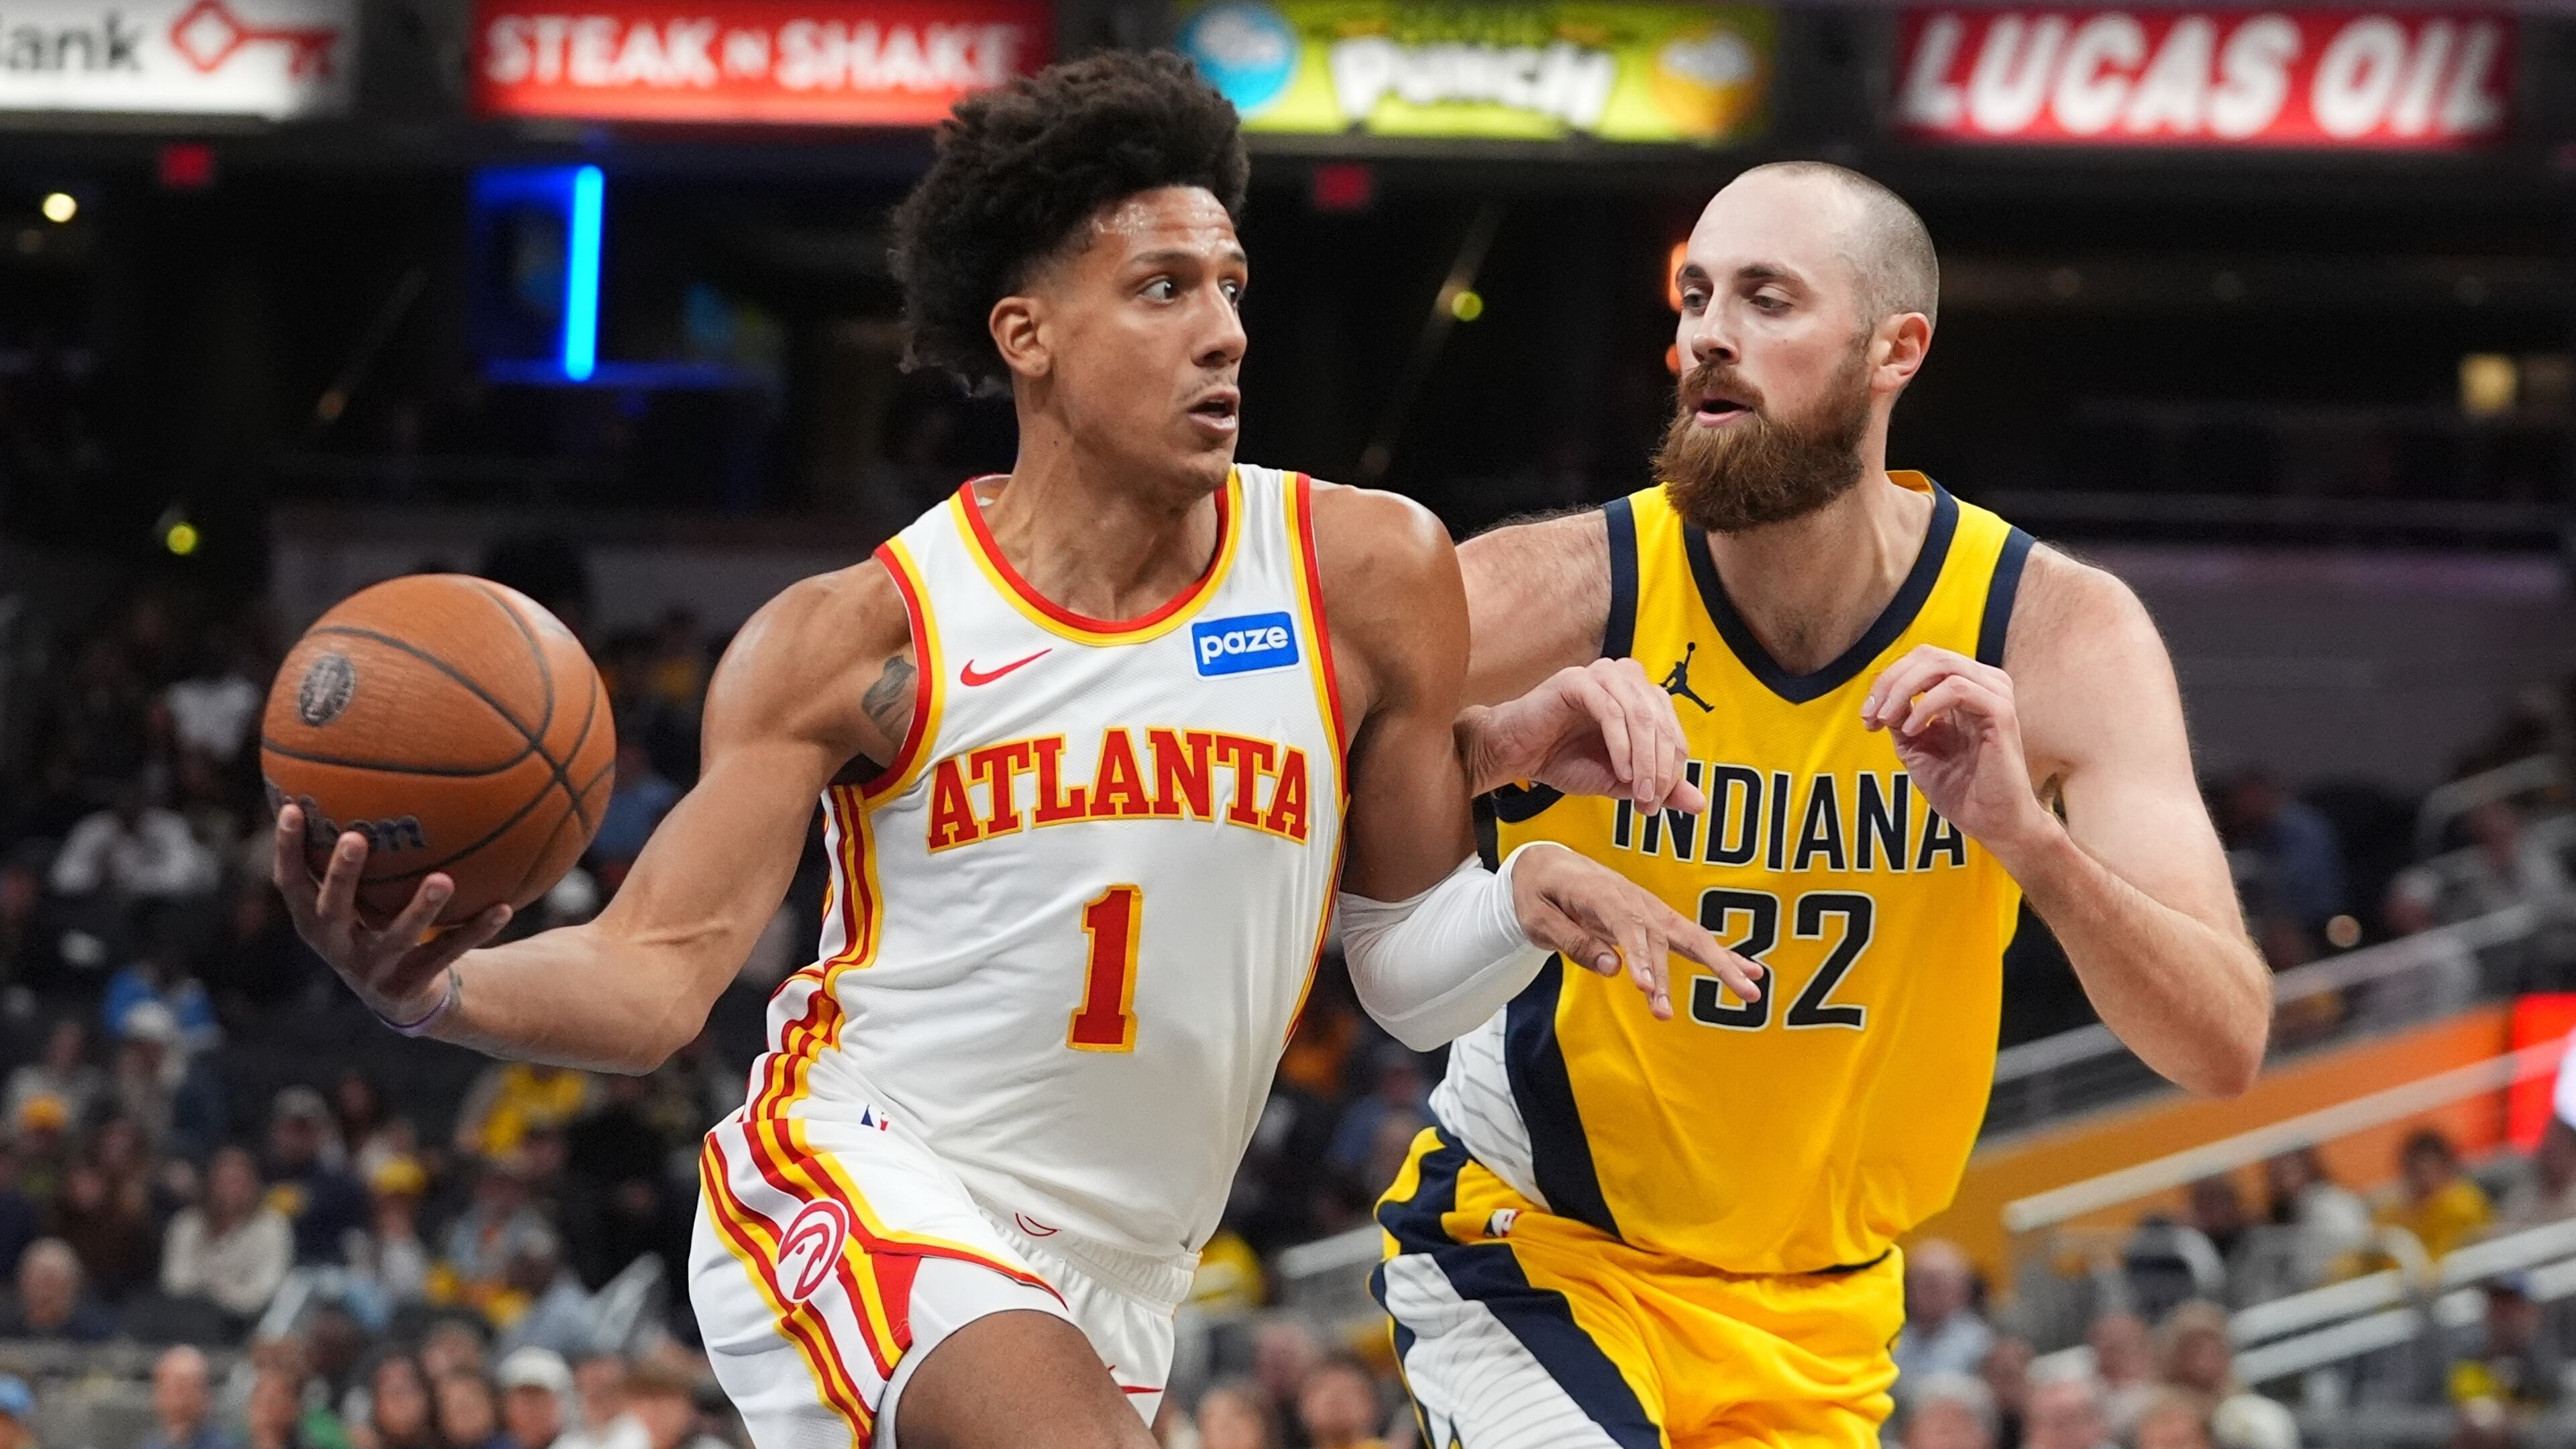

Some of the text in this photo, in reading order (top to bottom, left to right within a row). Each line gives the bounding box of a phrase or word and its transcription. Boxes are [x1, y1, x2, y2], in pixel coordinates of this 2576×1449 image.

[0, 8, 142, 72] ank
[487, 13, 719, 89] STEAK
[777, 18, 1021, 92] SHAKE
[1899, 11, 2507, 138] LUCAS OIL
[1199, 625, 1289, 665] paze
[926, 727, 1311, 854] ATLANTA
[1065, 883, 1142, 1053] 1
[1689, 887, 1876, 1032] 32
